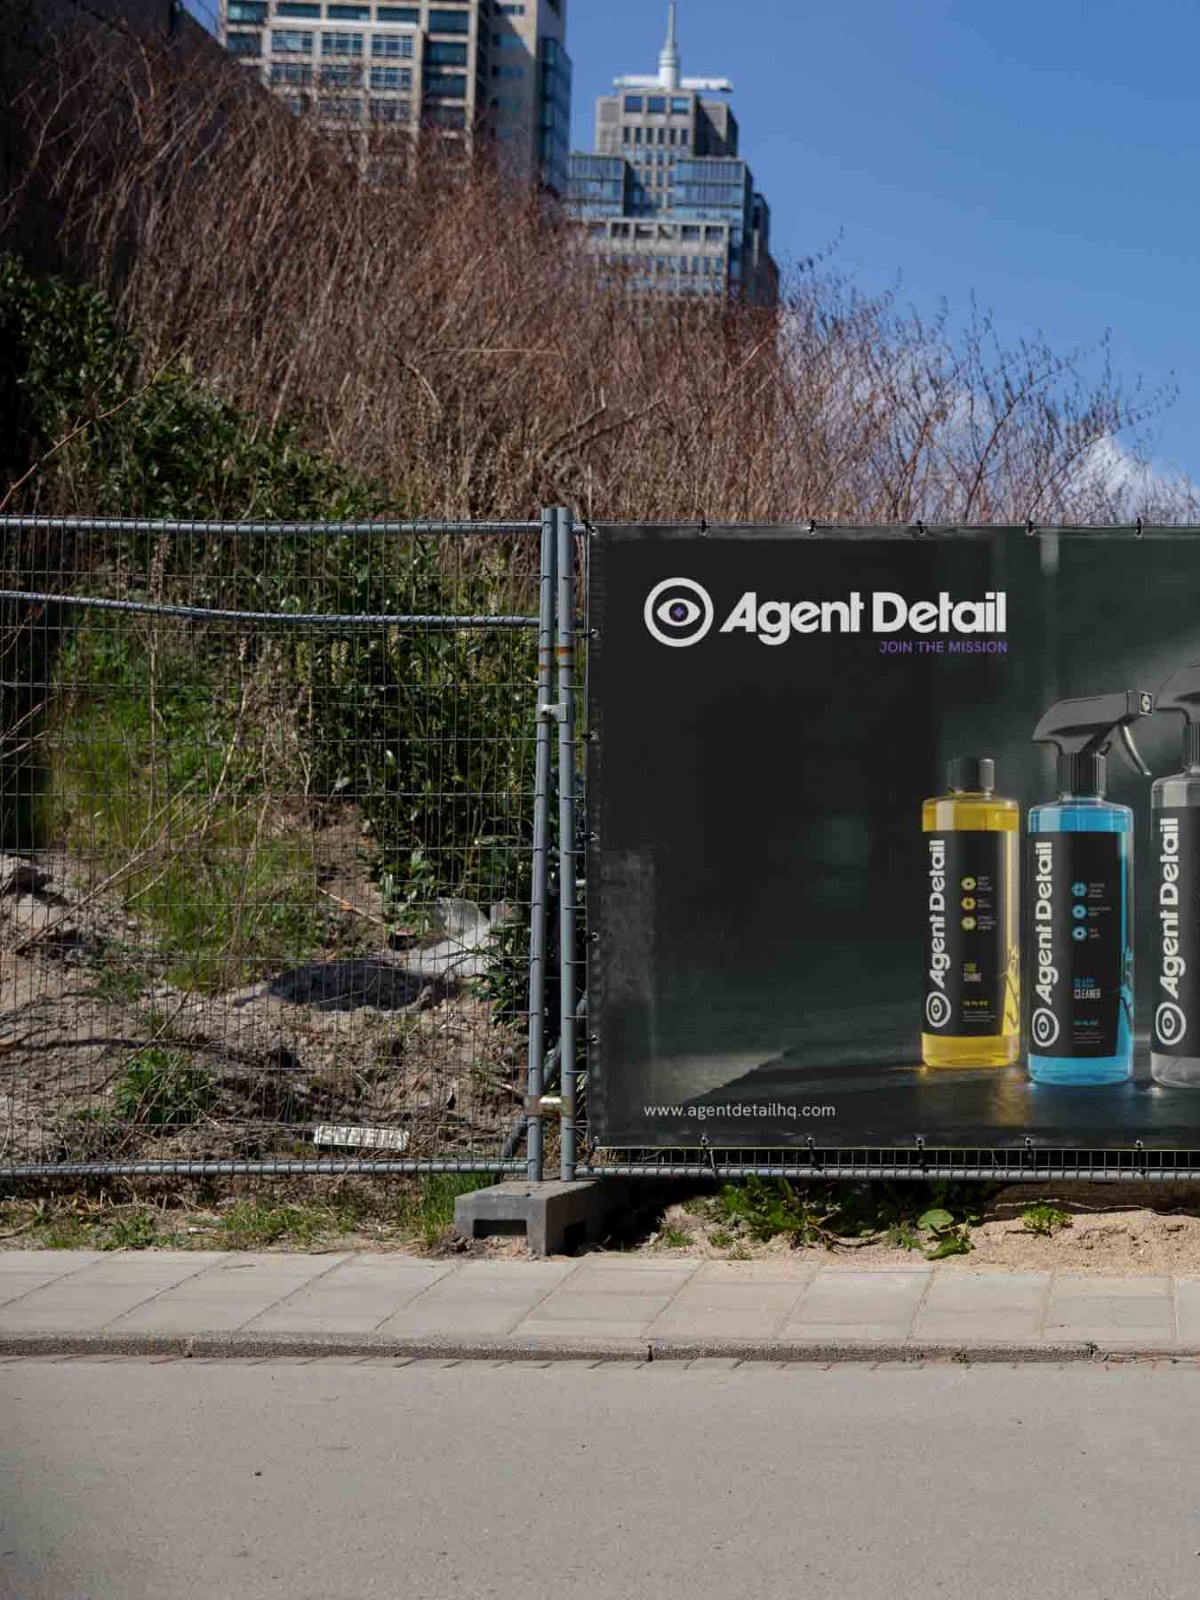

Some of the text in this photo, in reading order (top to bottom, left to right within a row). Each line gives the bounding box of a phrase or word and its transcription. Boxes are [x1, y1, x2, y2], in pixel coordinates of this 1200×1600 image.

[719, 592, 1007, 646] Agent Detail
[879, 641, 1008, 654] JOIN THE MISSION
[929, 840, 951, 989] Agent Detail
[1035, 841, 1059, 1005] Agent Detail
[1159, 818, 1186, 1000] Agent Detail
[1073, 988, 1102, 999] CLEANER
[643, 1103, 836, 1120] www.agentdetailhq.com
